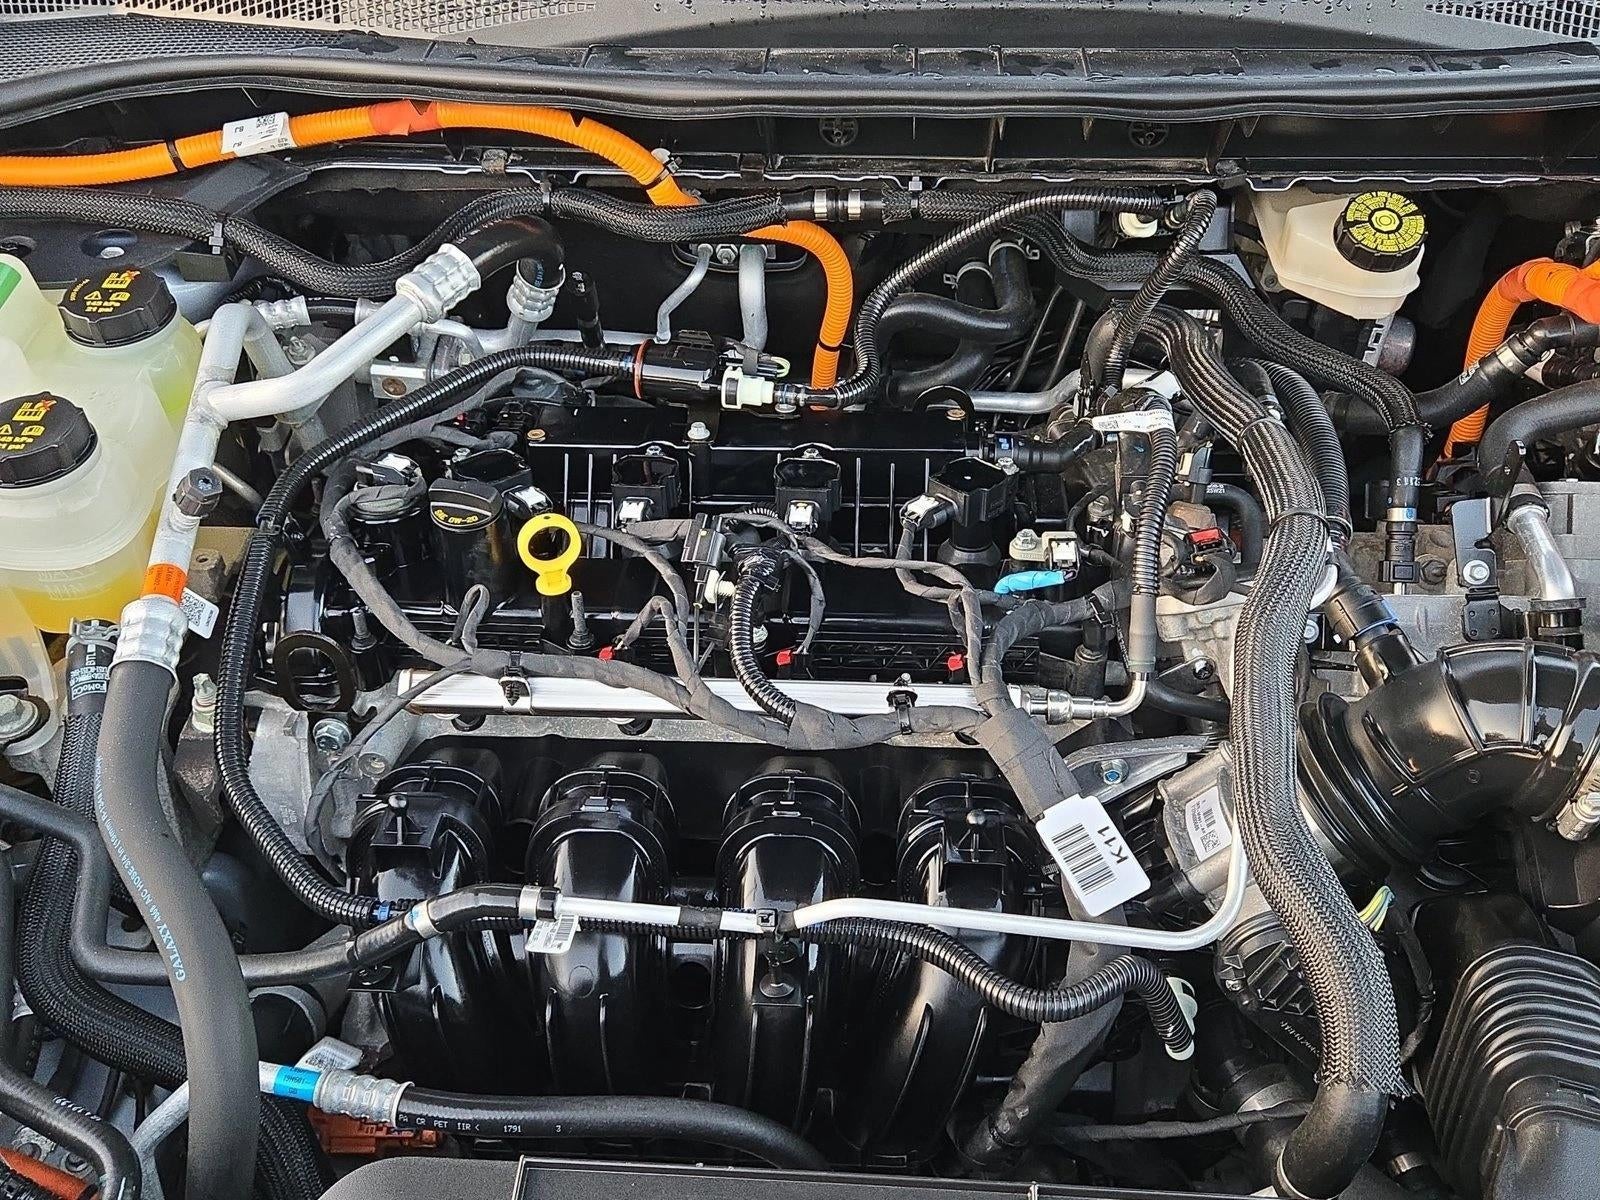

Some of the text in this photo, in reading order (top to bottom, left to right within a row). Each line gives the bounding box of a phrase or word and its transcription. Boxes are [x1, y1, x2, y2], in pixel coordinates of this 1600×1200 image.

[72, 683, 107, 696] FoMoCo
[1097, 826, 1129, 864] K11
[126, 866, 145, 892] HOSE
[156, 923, 186, 981] GALAXY
